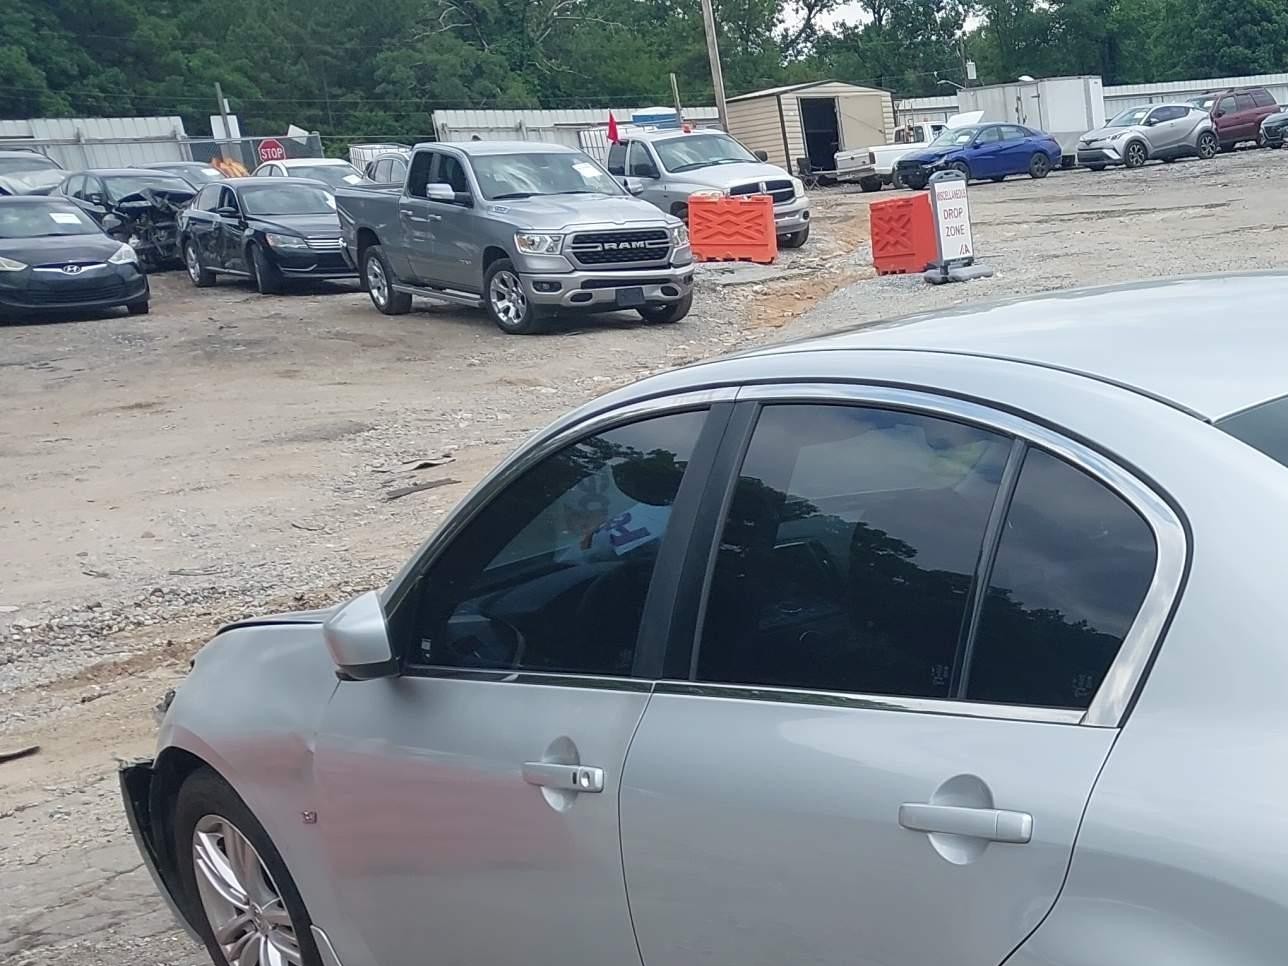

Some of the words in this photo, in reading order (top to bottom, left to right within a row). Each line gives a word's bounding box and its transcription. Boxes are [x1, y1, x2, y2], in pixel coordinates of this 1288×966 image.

[261, 148, 283, 159] STOP
[943, 208, 963, 220] DROP
[945, 224, 965, 237] ZONE
[604, 241, 645, 250] RAM
